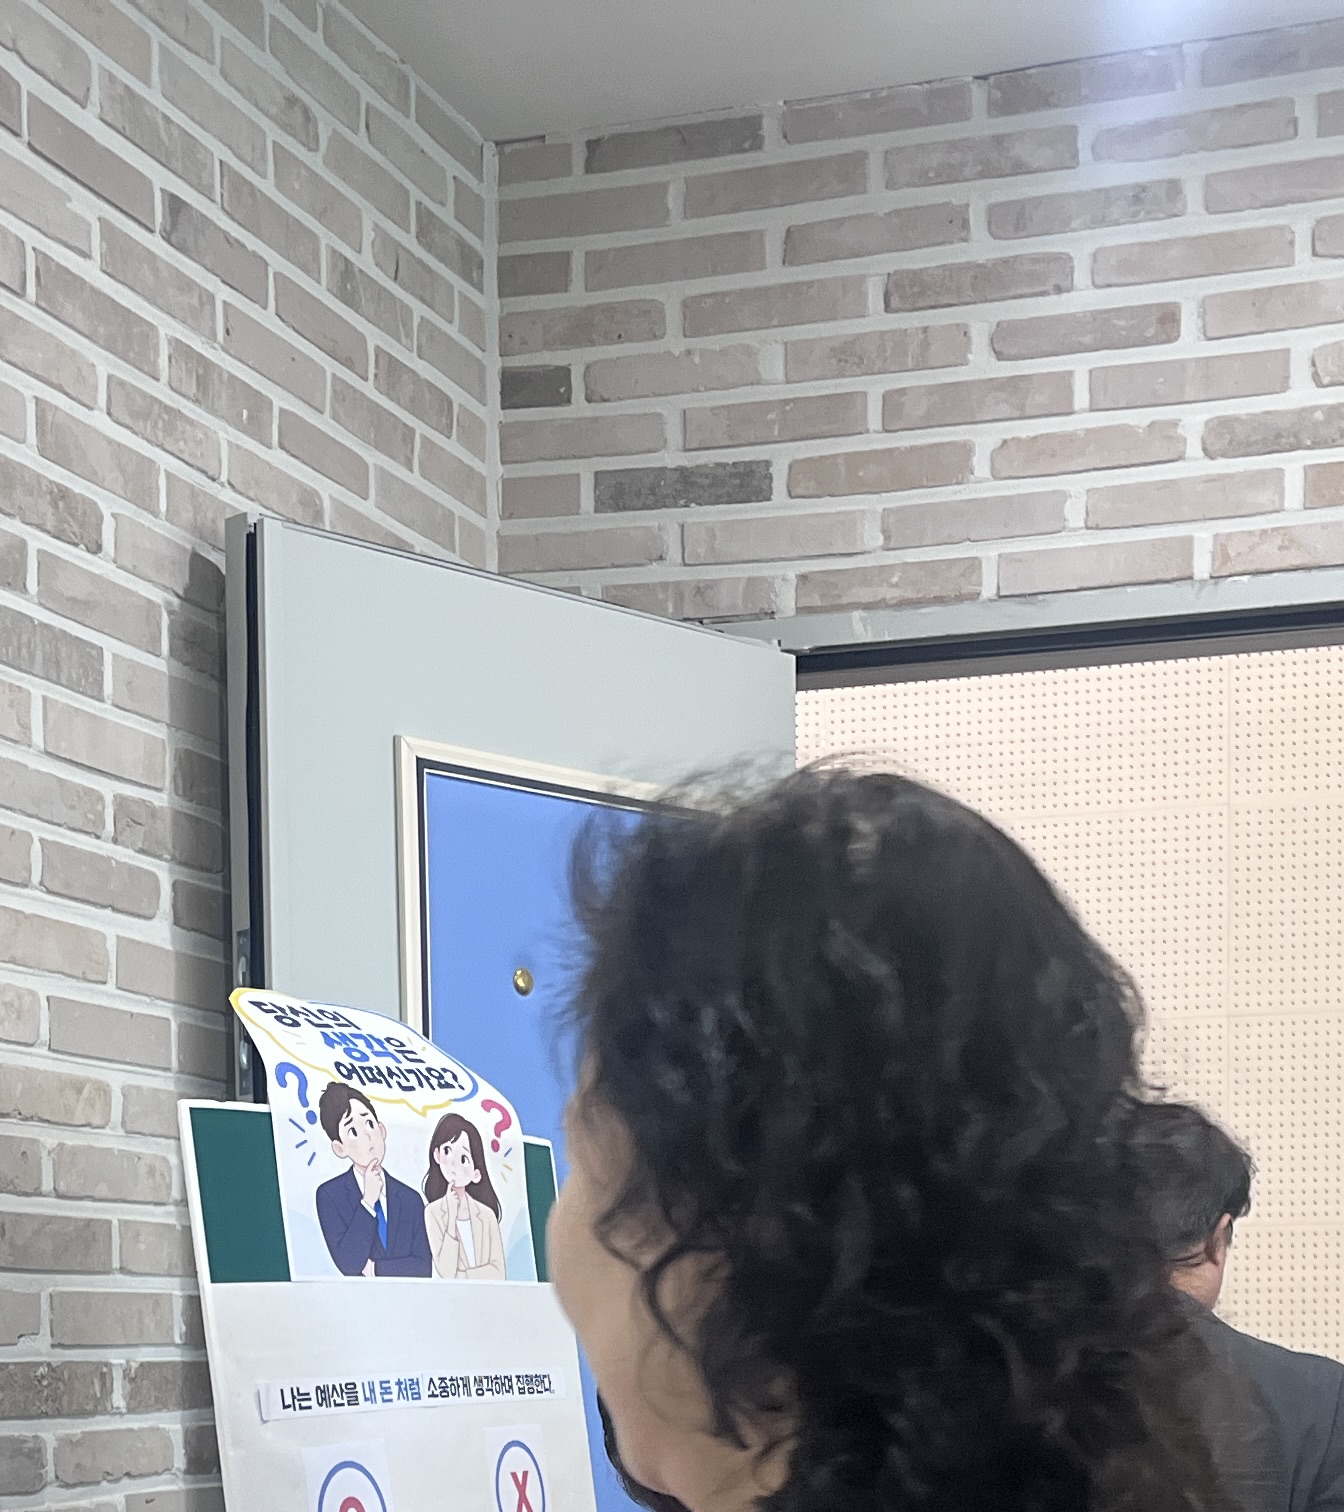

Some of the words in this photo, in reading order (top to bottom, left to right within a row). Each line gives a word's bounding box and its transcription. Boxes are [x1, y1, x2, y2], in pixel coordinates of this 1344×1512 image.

[248, 1000, 362, 1030] 당신의
[320, 1030, 426, 1064] 생각은
[334, 1061, 465, 1092] 어떠신가요?
[279, 1386, 312, 1411] 나는
[315, 1381, 360, 1408] 예산을
[361, 1380, 377, 1404] 내
[379, 1379, 394, 1403] 돈
[395, 1377, 422, 1401] 처럼
[427, 1375, 472, 1398] 소중하게
[473, 1374, 515, 1397] 생각하며
